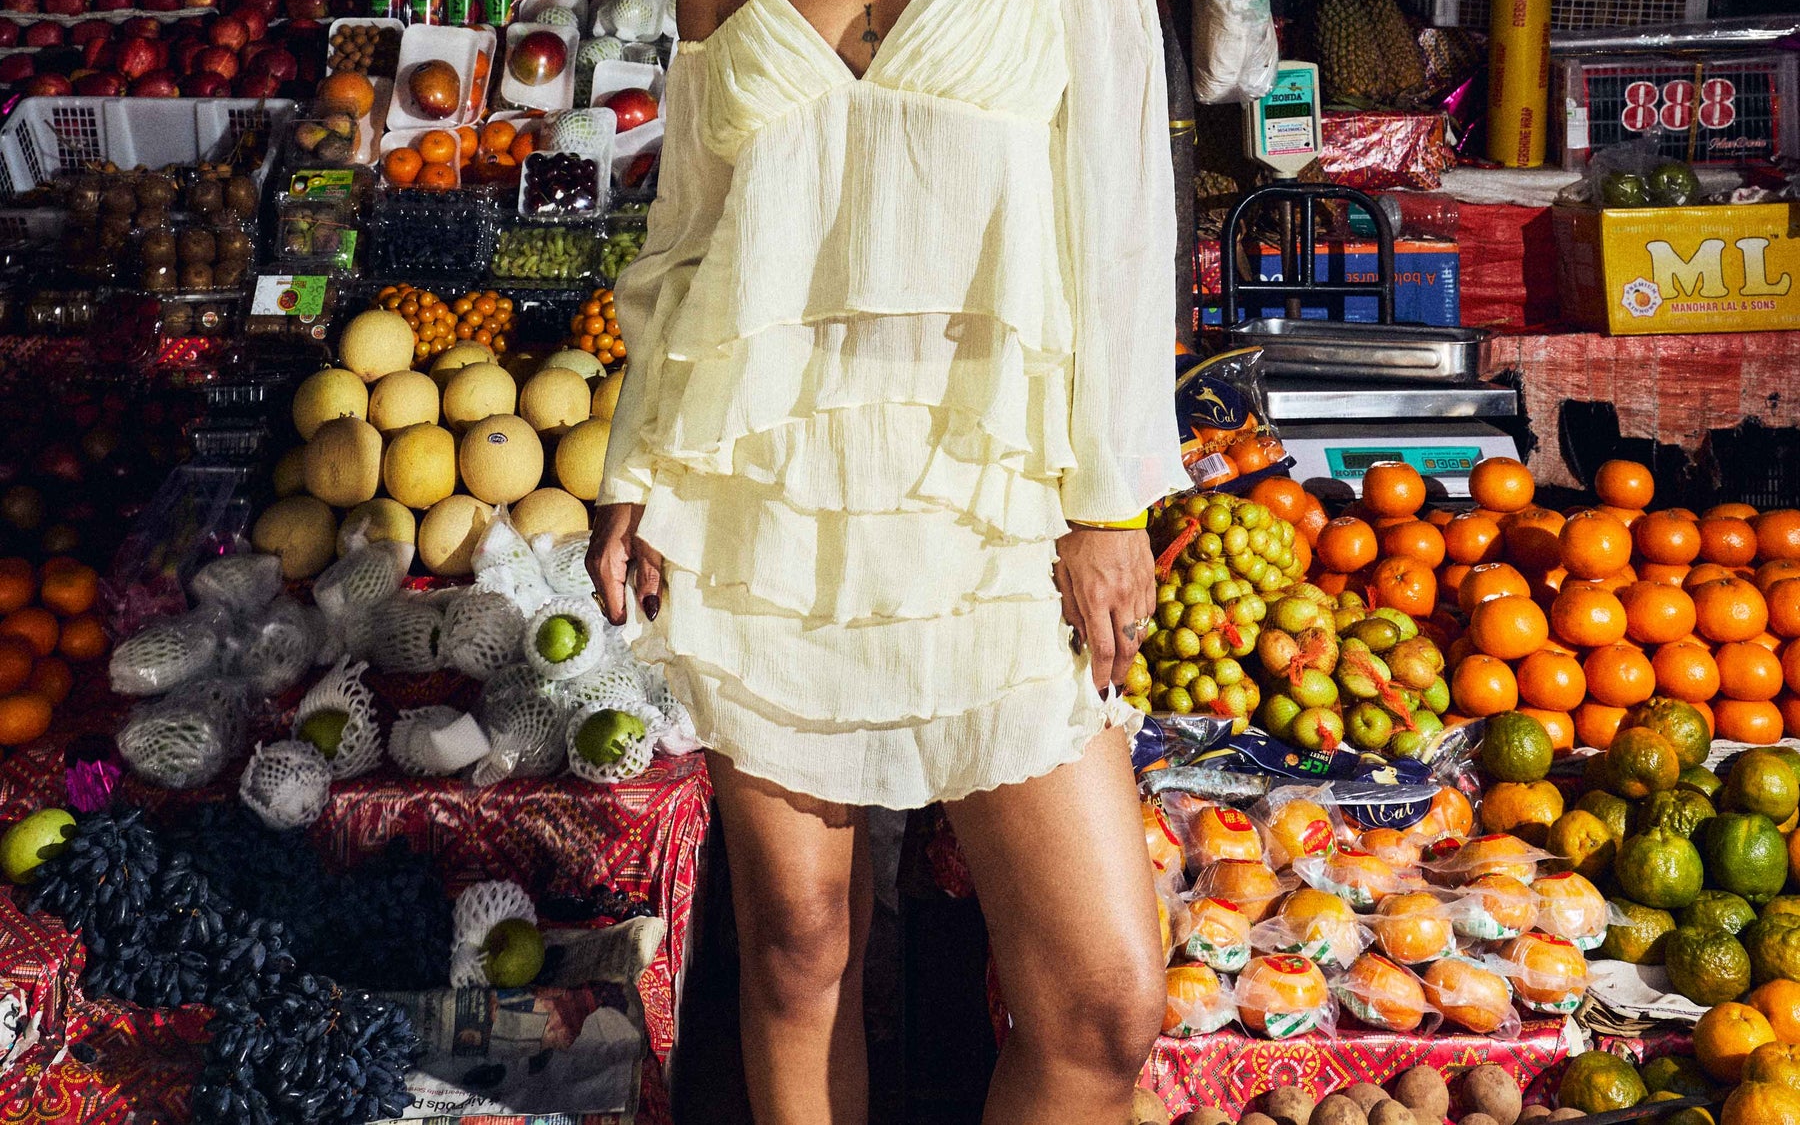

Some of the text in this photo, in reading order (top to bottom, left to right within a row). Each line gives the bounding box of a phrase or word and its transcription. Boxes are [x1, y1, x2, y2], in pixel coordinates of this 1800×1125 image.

[1271, 93, 1303, 103] HONDA
[1622, 78, 1736, 132] 888
[1517, 129, 1532, 167] VERSHINE
[1645, 236, 1792, 300] ML
[1626, 281, 1657, 295] PREMIUM
[1671, 300, 1776, 313] MANOHAR LAL & SONS
[1334, 469, 1365, 477] HOND
